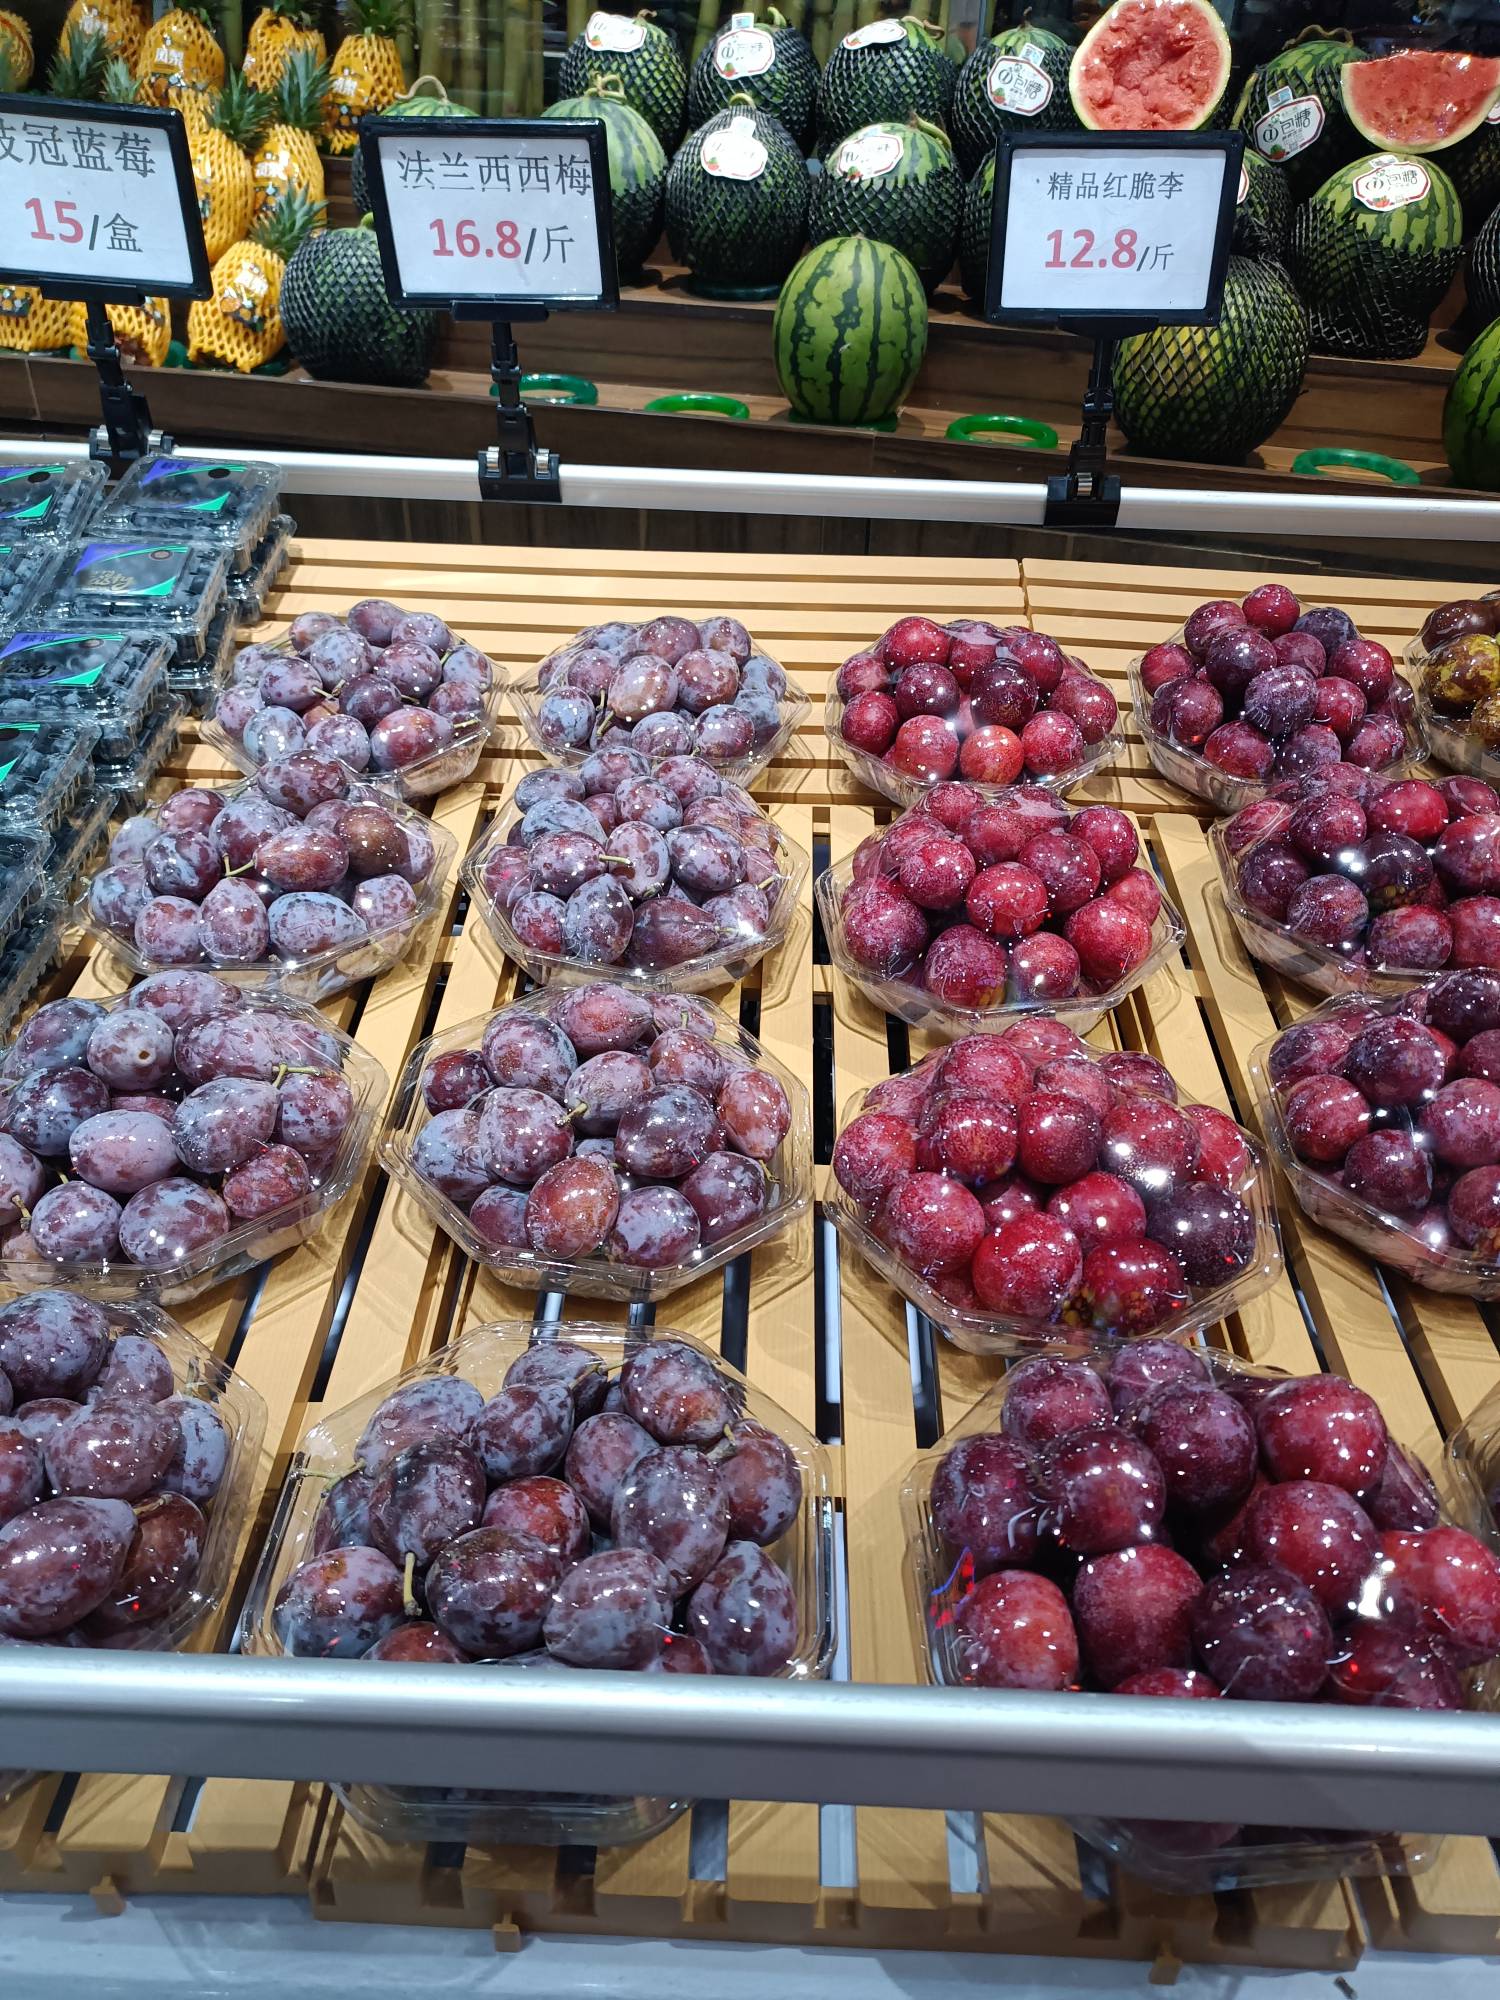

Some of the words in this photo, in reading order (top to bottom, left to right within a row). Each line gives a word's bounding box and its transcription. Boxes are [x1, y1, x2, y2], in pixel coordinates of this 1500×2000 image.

[397, 150, 592, 195] 法兰西西梅
[1047, 171, 1184, 200] 精品红脆李
[429, 218, 575, 264] 16.8/斤
[1045, 229, 1174, 272] 12.8/斤
